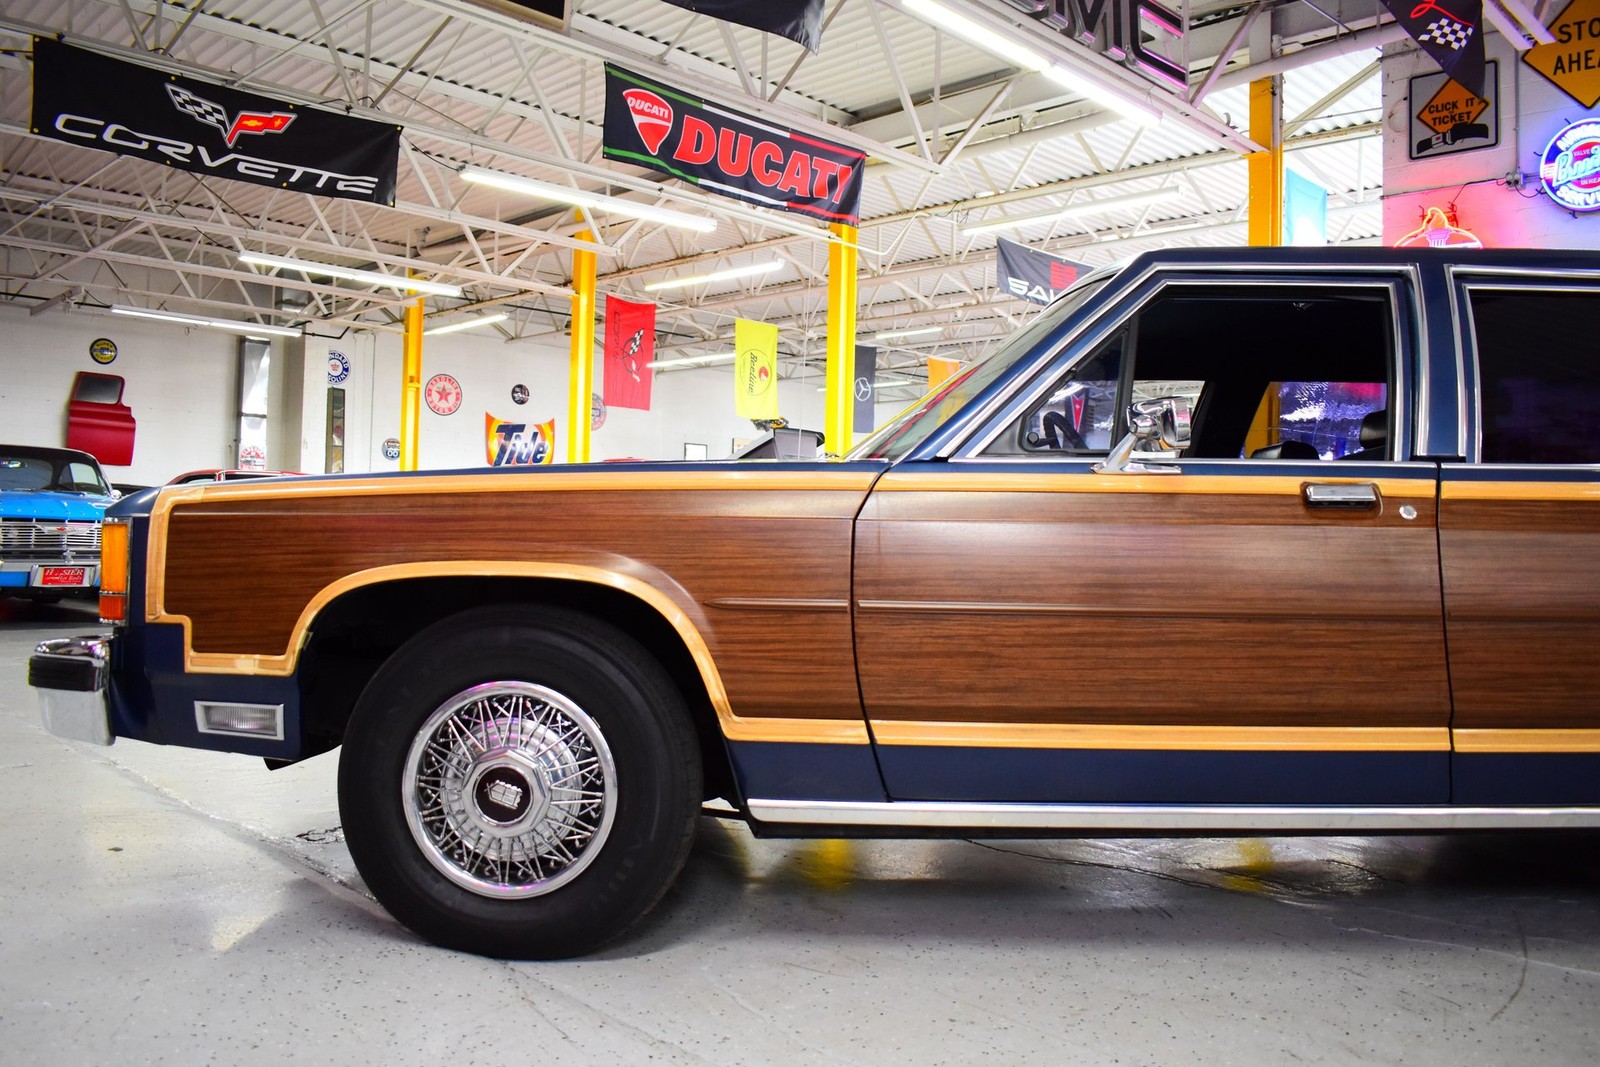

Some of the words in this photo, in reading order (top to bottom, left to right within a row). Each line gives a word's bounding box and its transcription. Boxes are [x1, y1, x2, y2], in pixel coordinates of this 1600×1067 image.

[1557, 17, 1600, 44] STO
[1001, 0, 1190, 95] MC
[1553, 49, 1600, 76] AHE
[626, 96, 670, 119] DUCATI
[1428, 100, 1458, 115] CLICK
[1465, 97, 1475, 107] IT
[1431, 111, 1472, 126] TICKET
[55, 113, 380, 195] CORVETTE
[673, 114, 853, 204] DUCATI
[328, 352, 349, 368] NDARD
[493, 423, 548, 467] Tide
